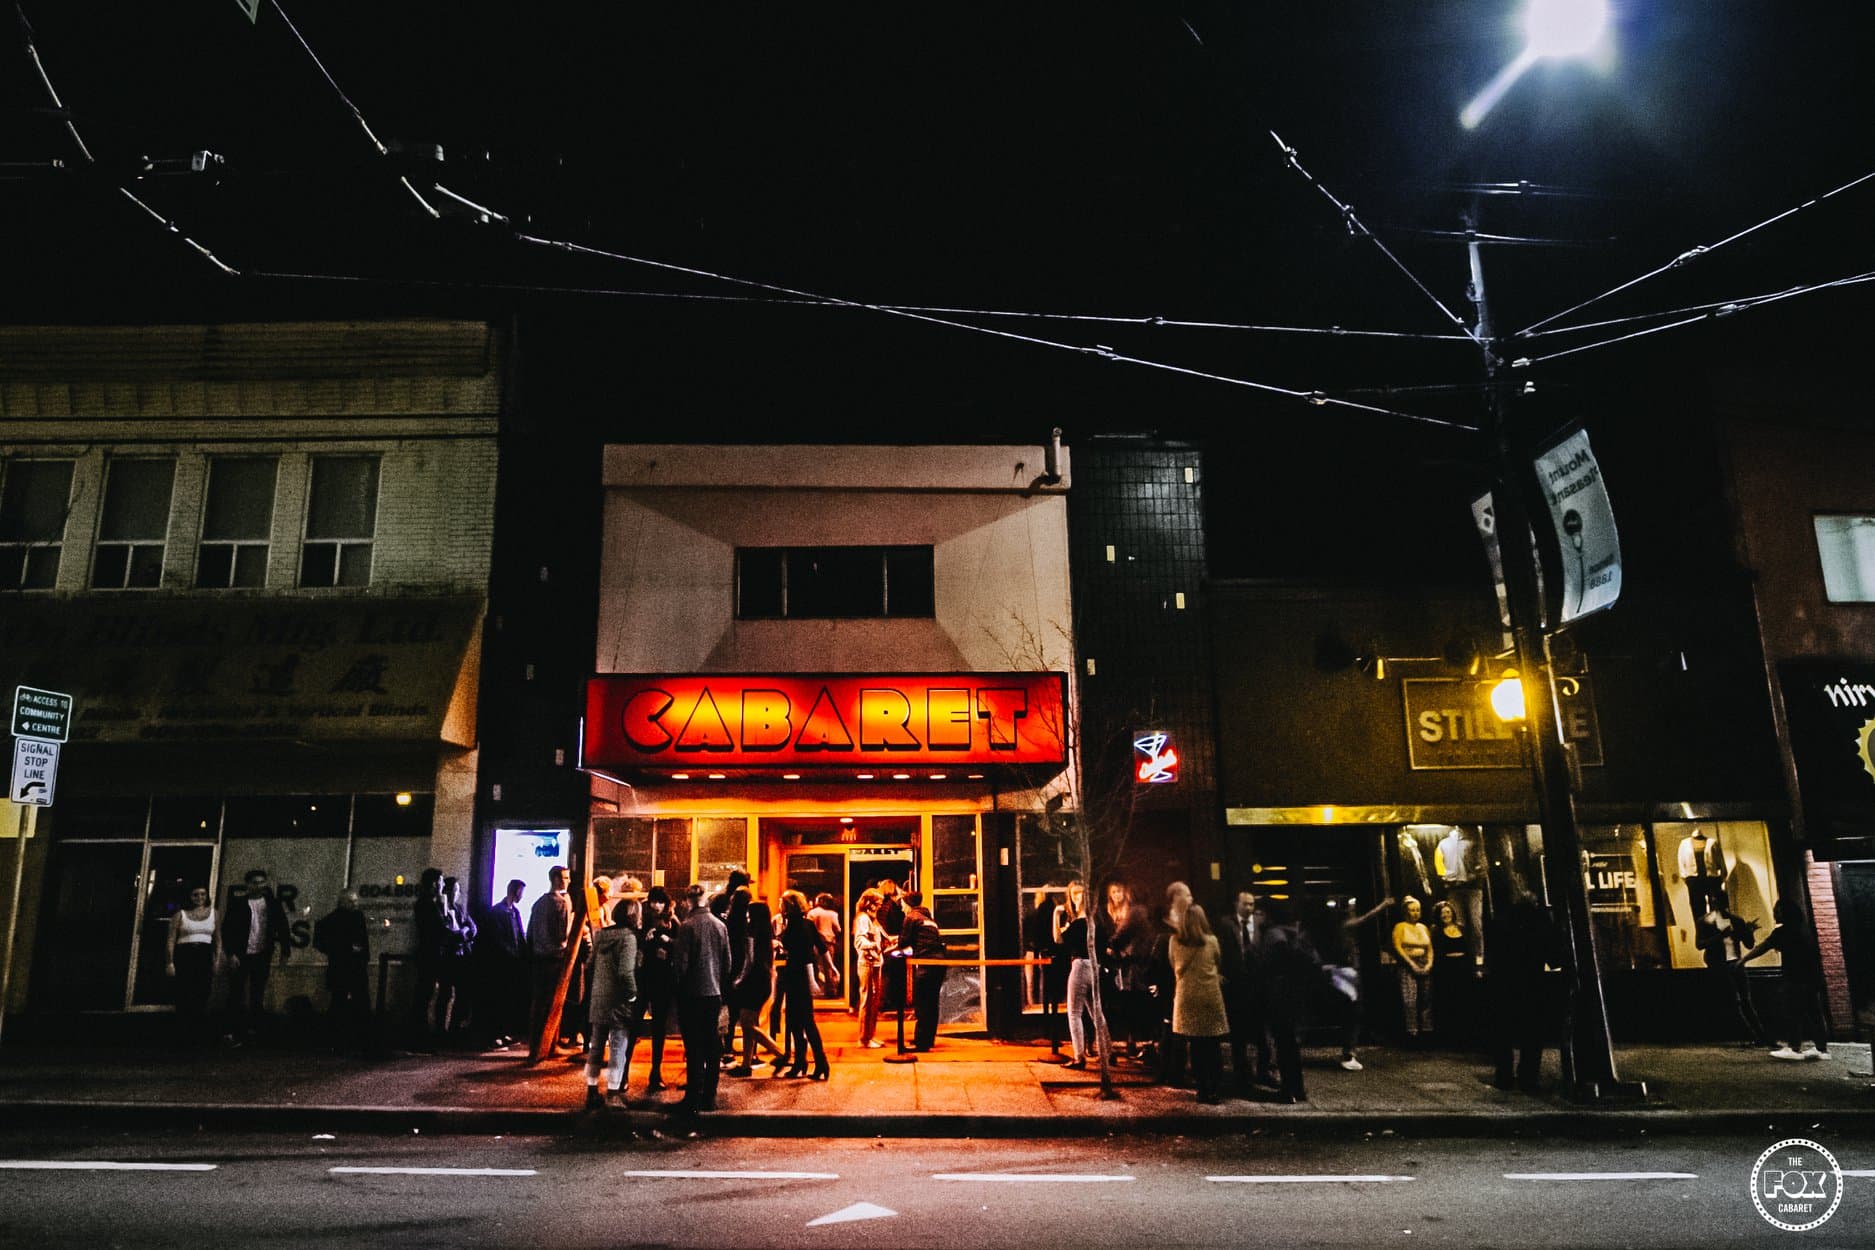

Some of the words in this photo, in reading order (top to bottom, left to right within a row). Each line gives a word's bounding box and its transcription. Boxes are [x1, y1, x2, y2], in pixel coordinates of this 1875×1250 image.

[33, 695, 58, 707] ACCESS
[61, 700, 68, 709] TO
[20, 706, 64, 721] COMMUNITY
[621, 686, 1027, 753] CABARET
[31, 722, 61, 735] CENTRE
[20, 742, 54, 756] SIGNAL
[24, 756, 48, 768] STOP
[24, 769, 45, 780] LINE
[1598, 871, 1637, 889] LIFE
